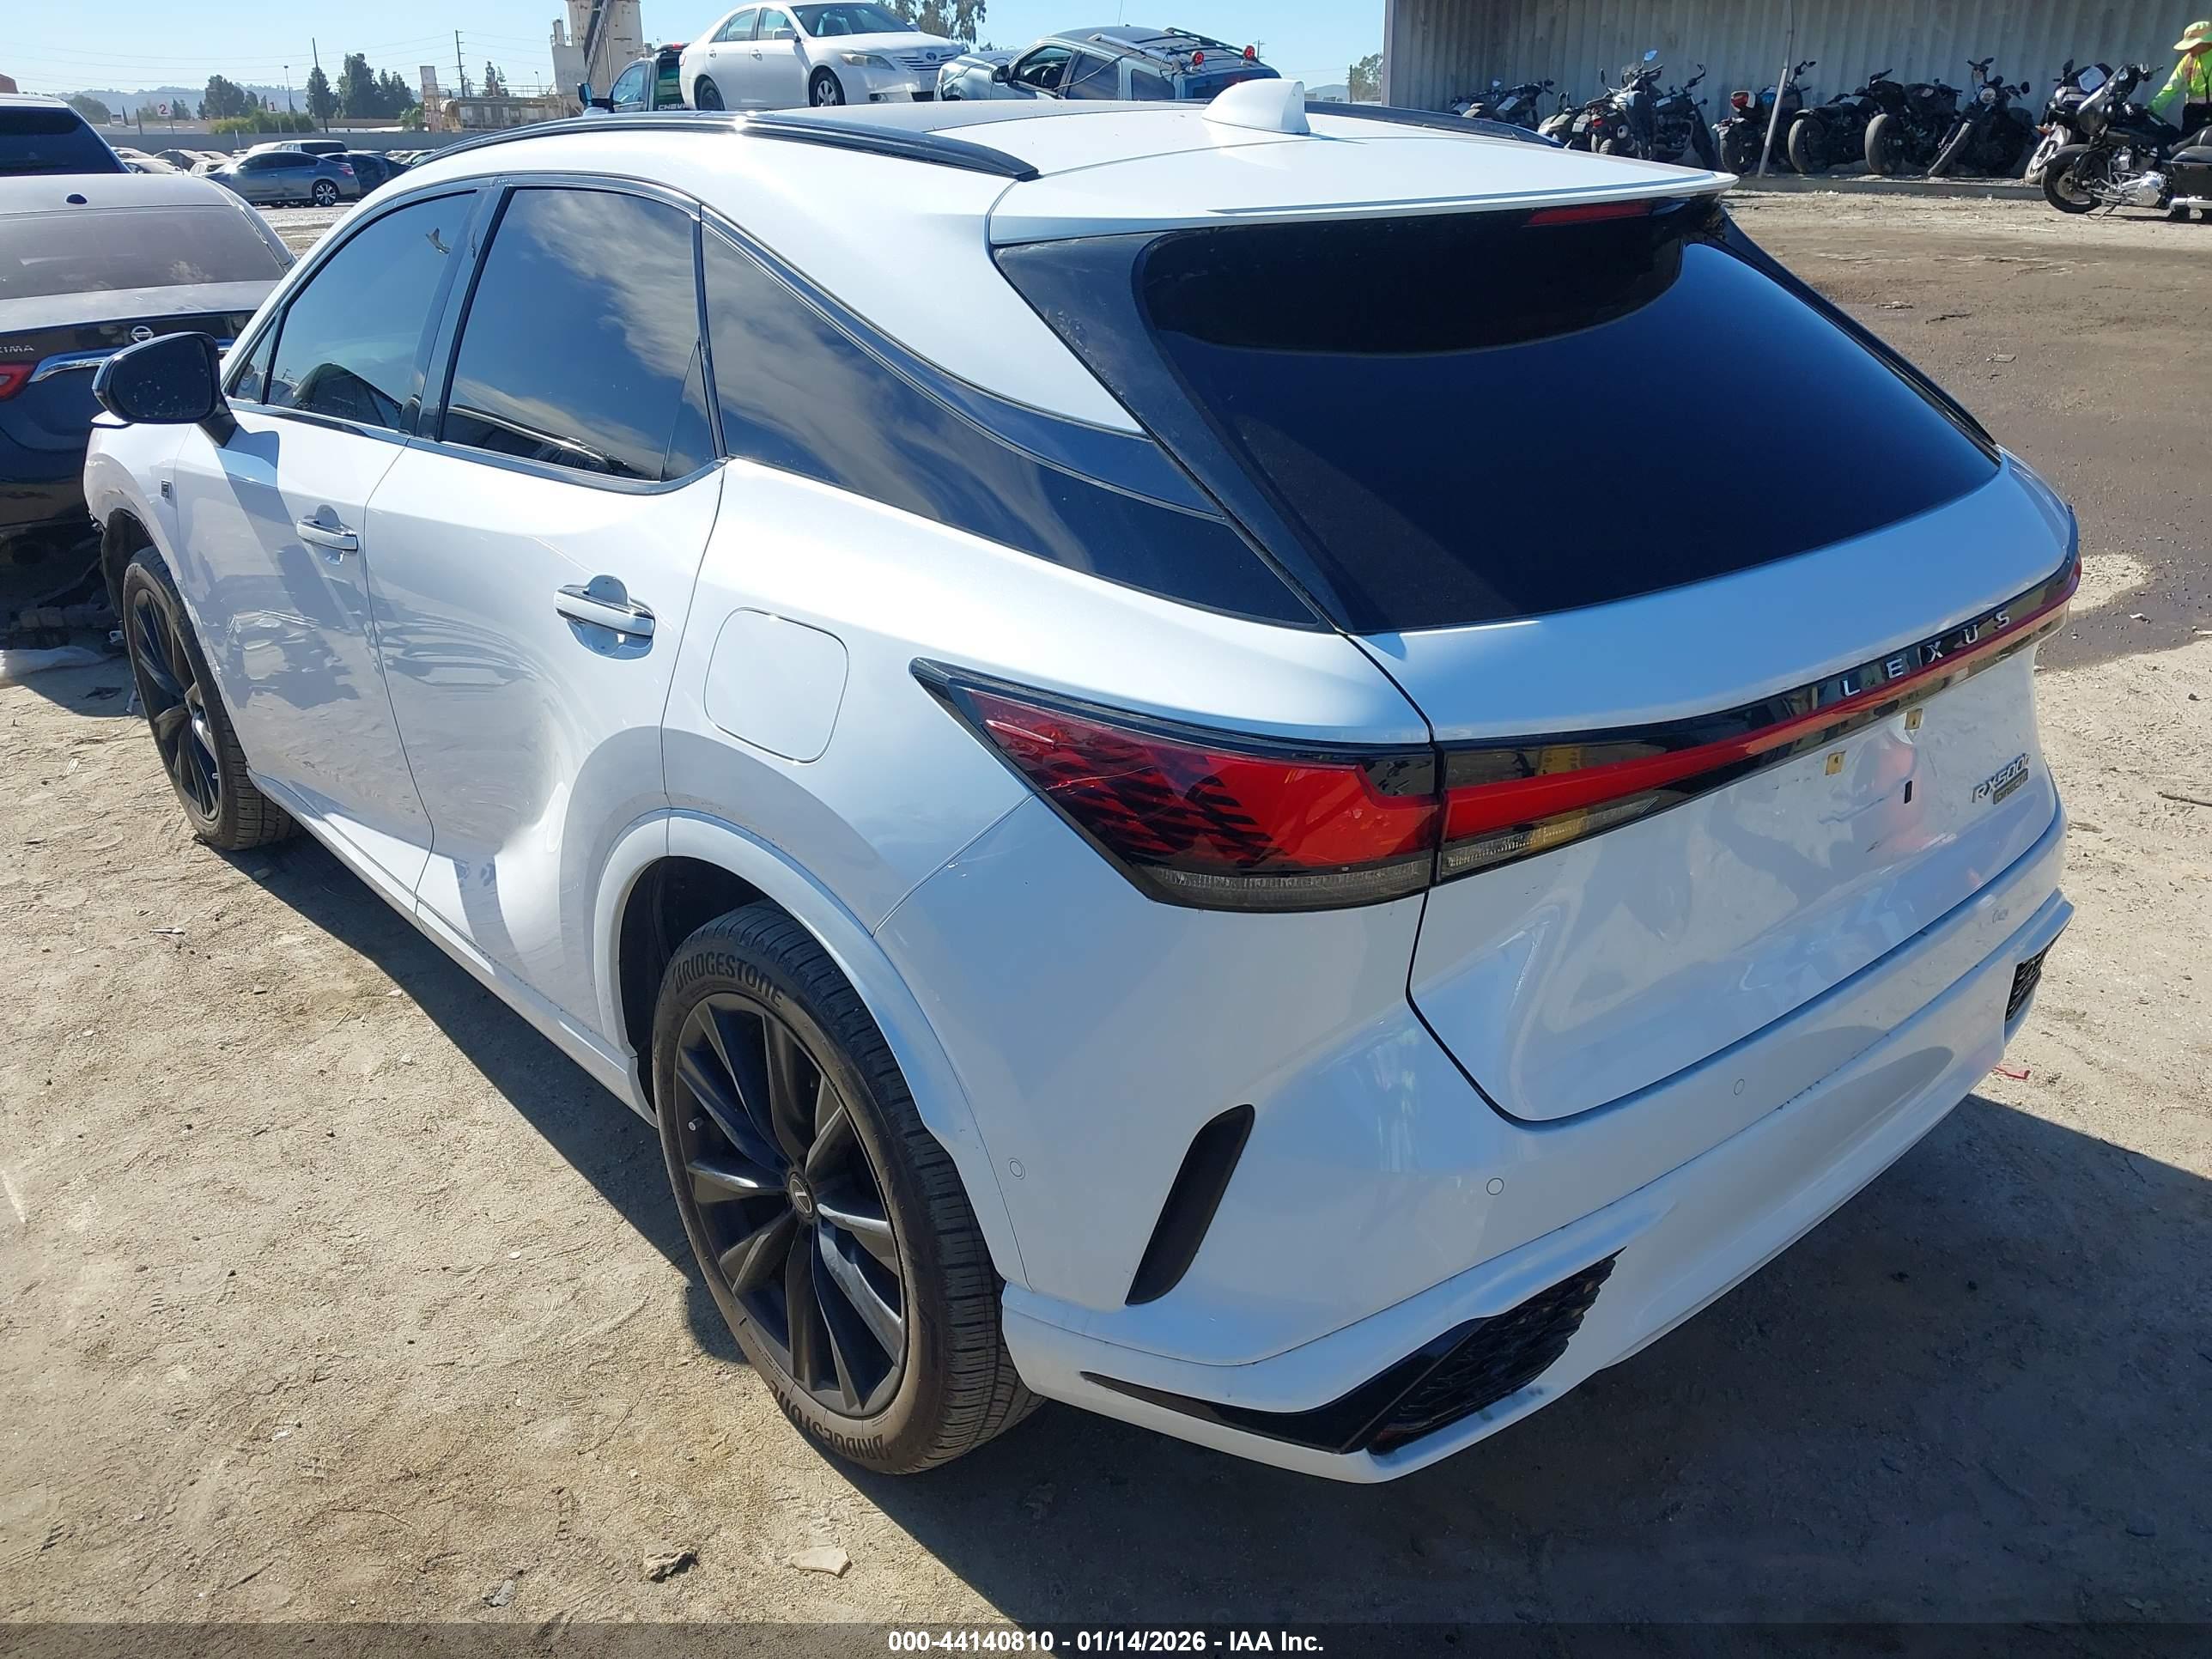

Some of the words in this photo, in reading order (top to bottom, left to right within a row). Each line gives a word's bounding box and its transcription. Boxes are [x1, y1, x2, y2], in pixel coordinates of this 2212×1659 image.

[158, 103, 168, 115] 2
[270, 100, 277, 112] 1
[1841, 610, 2011, 697] LEXUS
[672, 951, 786, 1008] BRIDGESTONE
